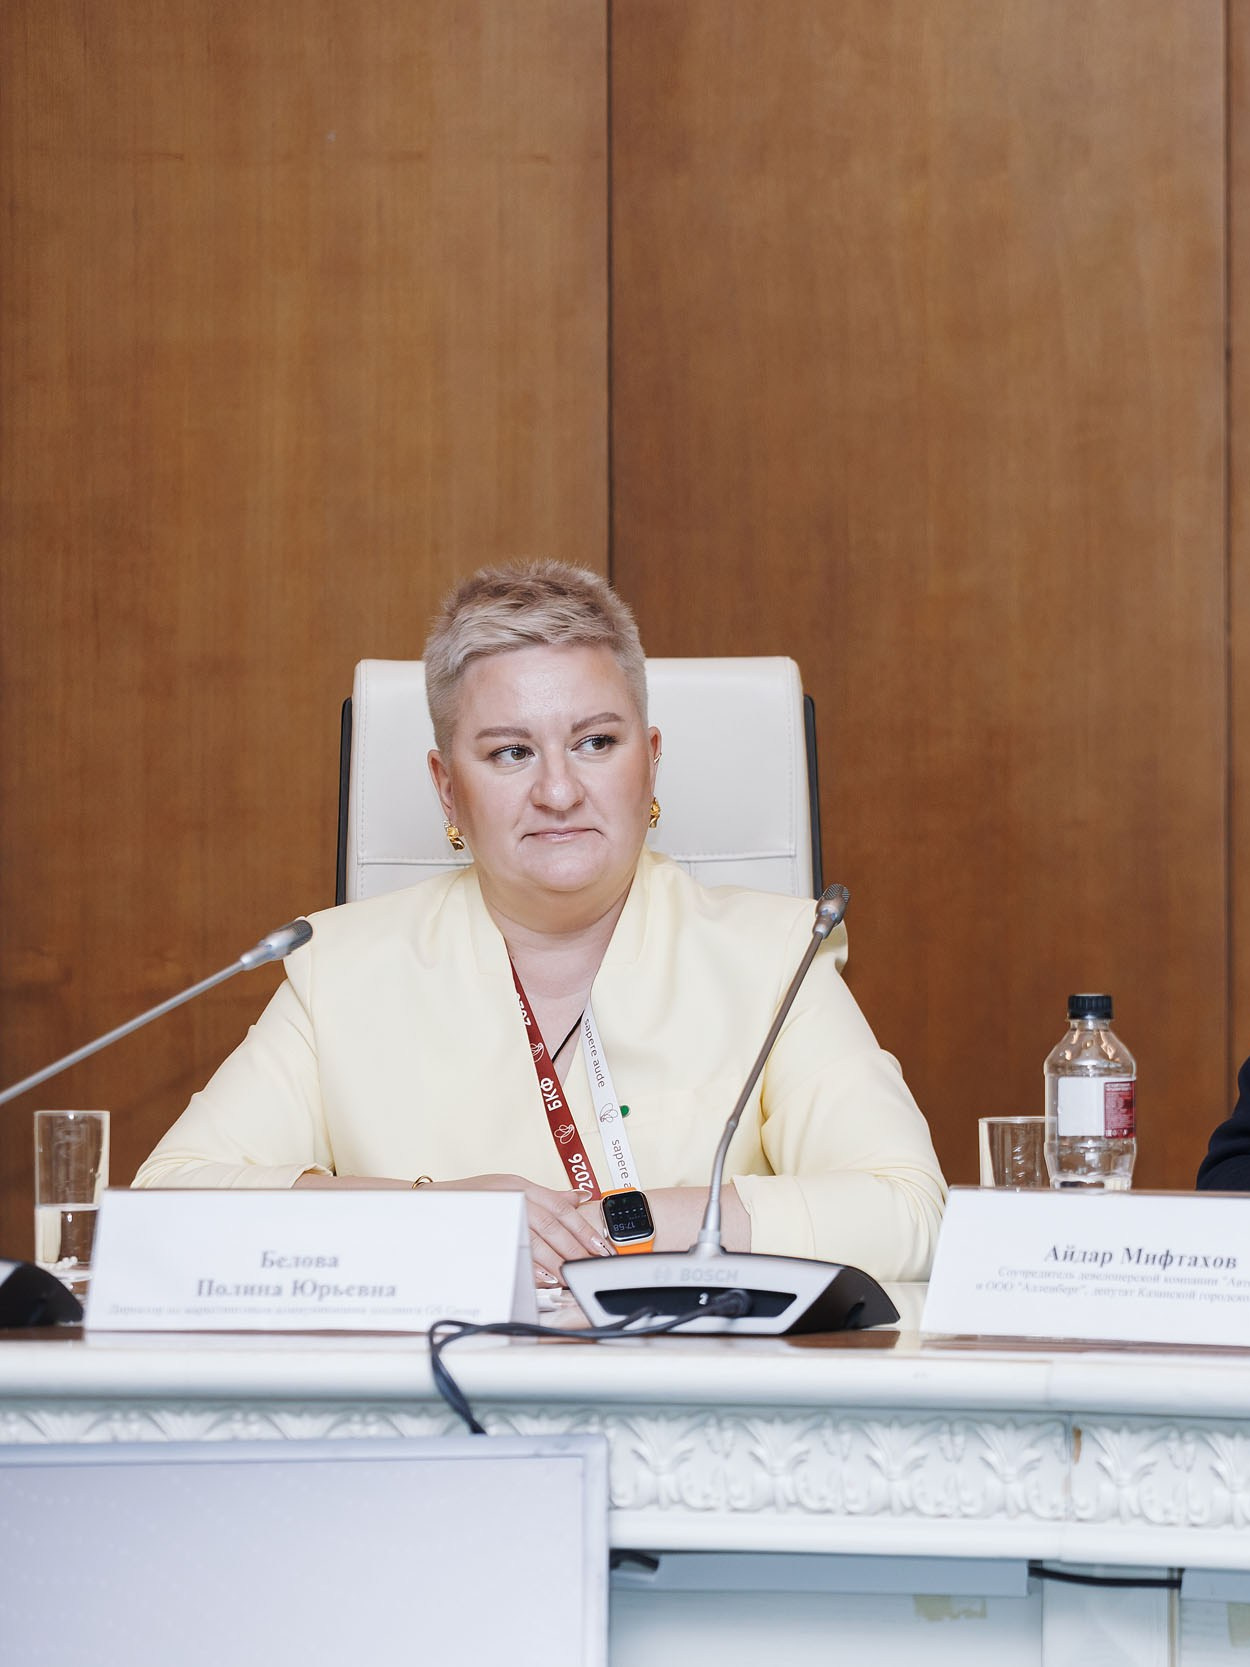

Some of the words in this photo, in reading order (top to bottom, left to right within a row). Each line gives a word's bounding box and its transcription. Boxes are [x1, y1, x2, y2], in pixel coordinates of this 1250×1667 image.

[584, 1018, 598, 1057] sapere
[592, 1060, 606, 1089] aude
[540, 1077, 563, 1111] БКФ
[568, 1153, 594, 1191] 2026
[611, 1139, 629, 1179] sapere
[260, 1250, 340, 1270] Белова
[1043, 1245, 1113, 1268] Айдар
[1121, 1246, 1237, 1270] Мифтахов
[680, 1267, 739, 1282] BOSCH
[197, 1278, 283, 1297] Полина
[291, 1278, 398, 1302] Юрьевна
